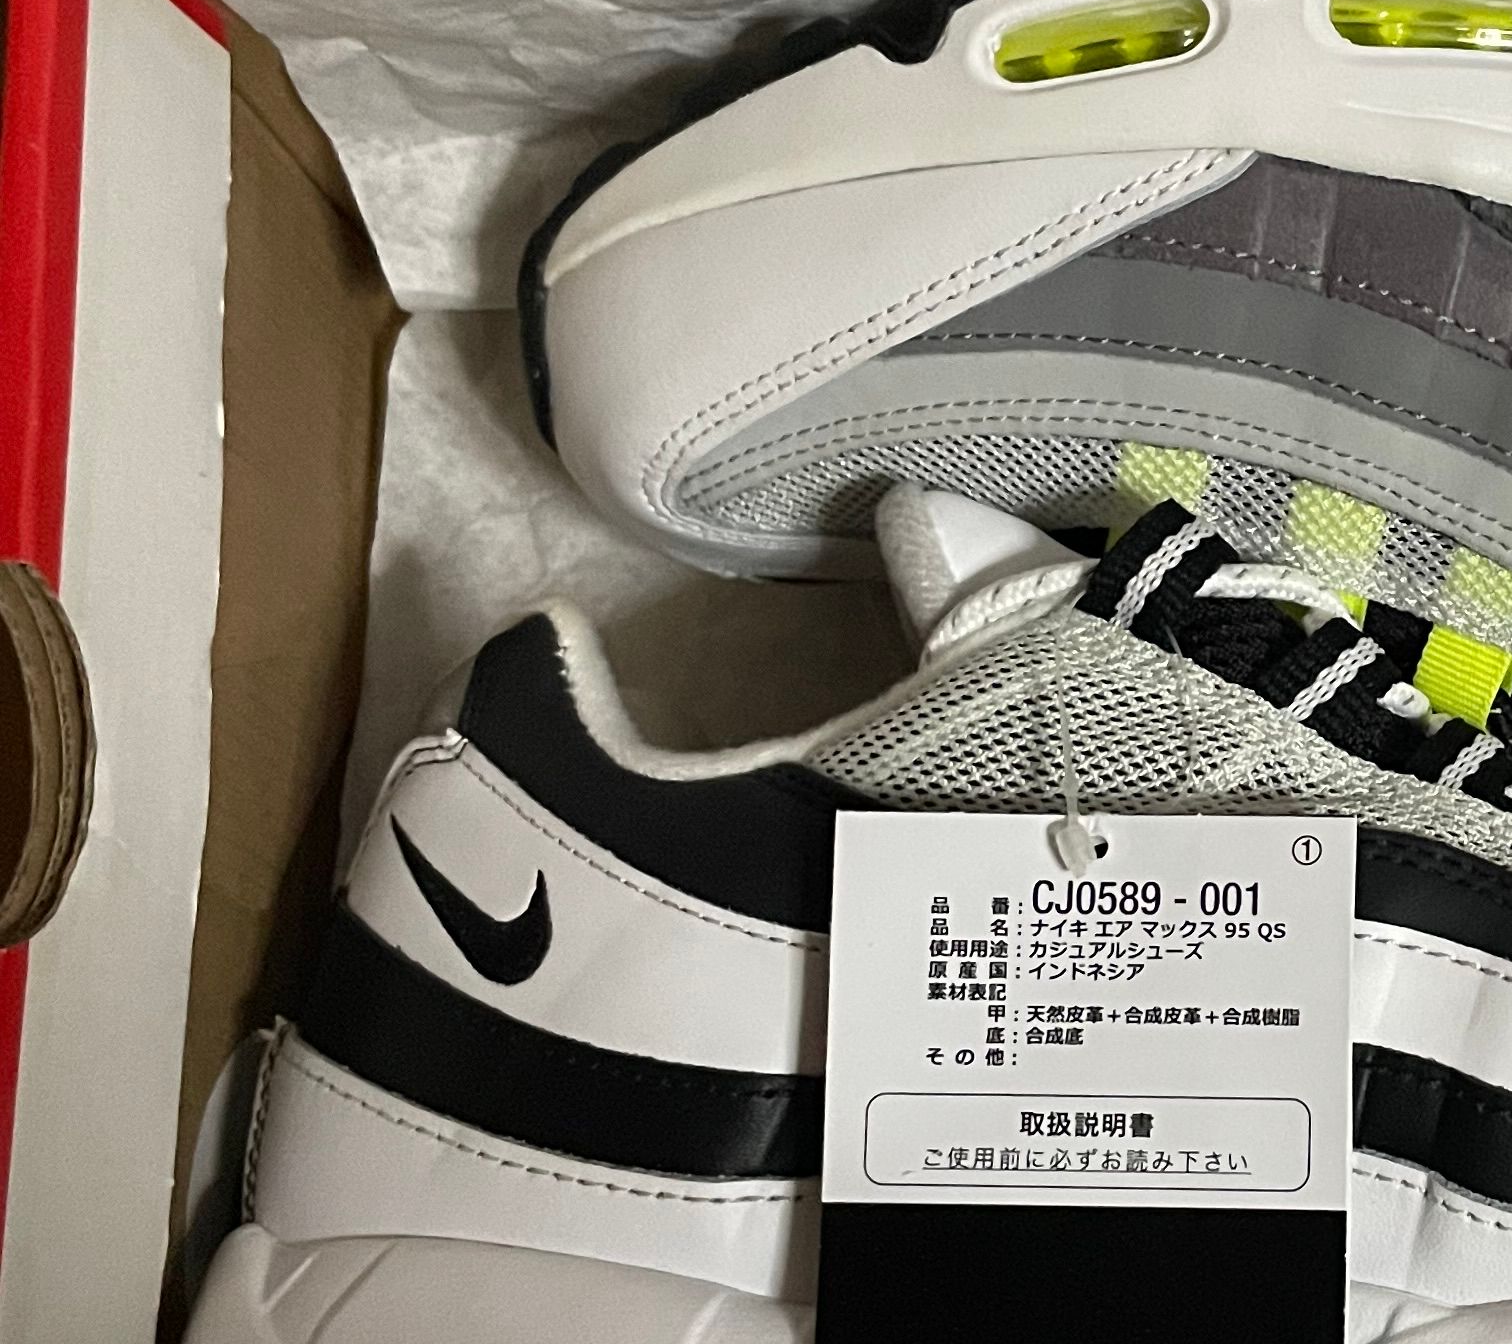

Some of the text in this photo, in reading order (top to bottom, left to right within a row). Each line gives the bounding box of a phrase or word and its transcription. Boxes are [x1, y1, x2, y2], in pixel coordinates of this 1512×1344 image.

[1032, 879, 1161, 916] CJ0589
[1200, 881, 1259, 917] 001
[1030, 918, 1089, 938] ナイキ
[1094, 920, 1133, 938] エア
[1140, 920, 1218, 939] マックス
[1224, 922, 1251, 939] 95
[1257, 922, 1287, 943] QS
[1019, 1111, 1155, 1139] 取扱説明書
[922, 1147, 1252, 1175] ご使用前に必ずお読み下さい
